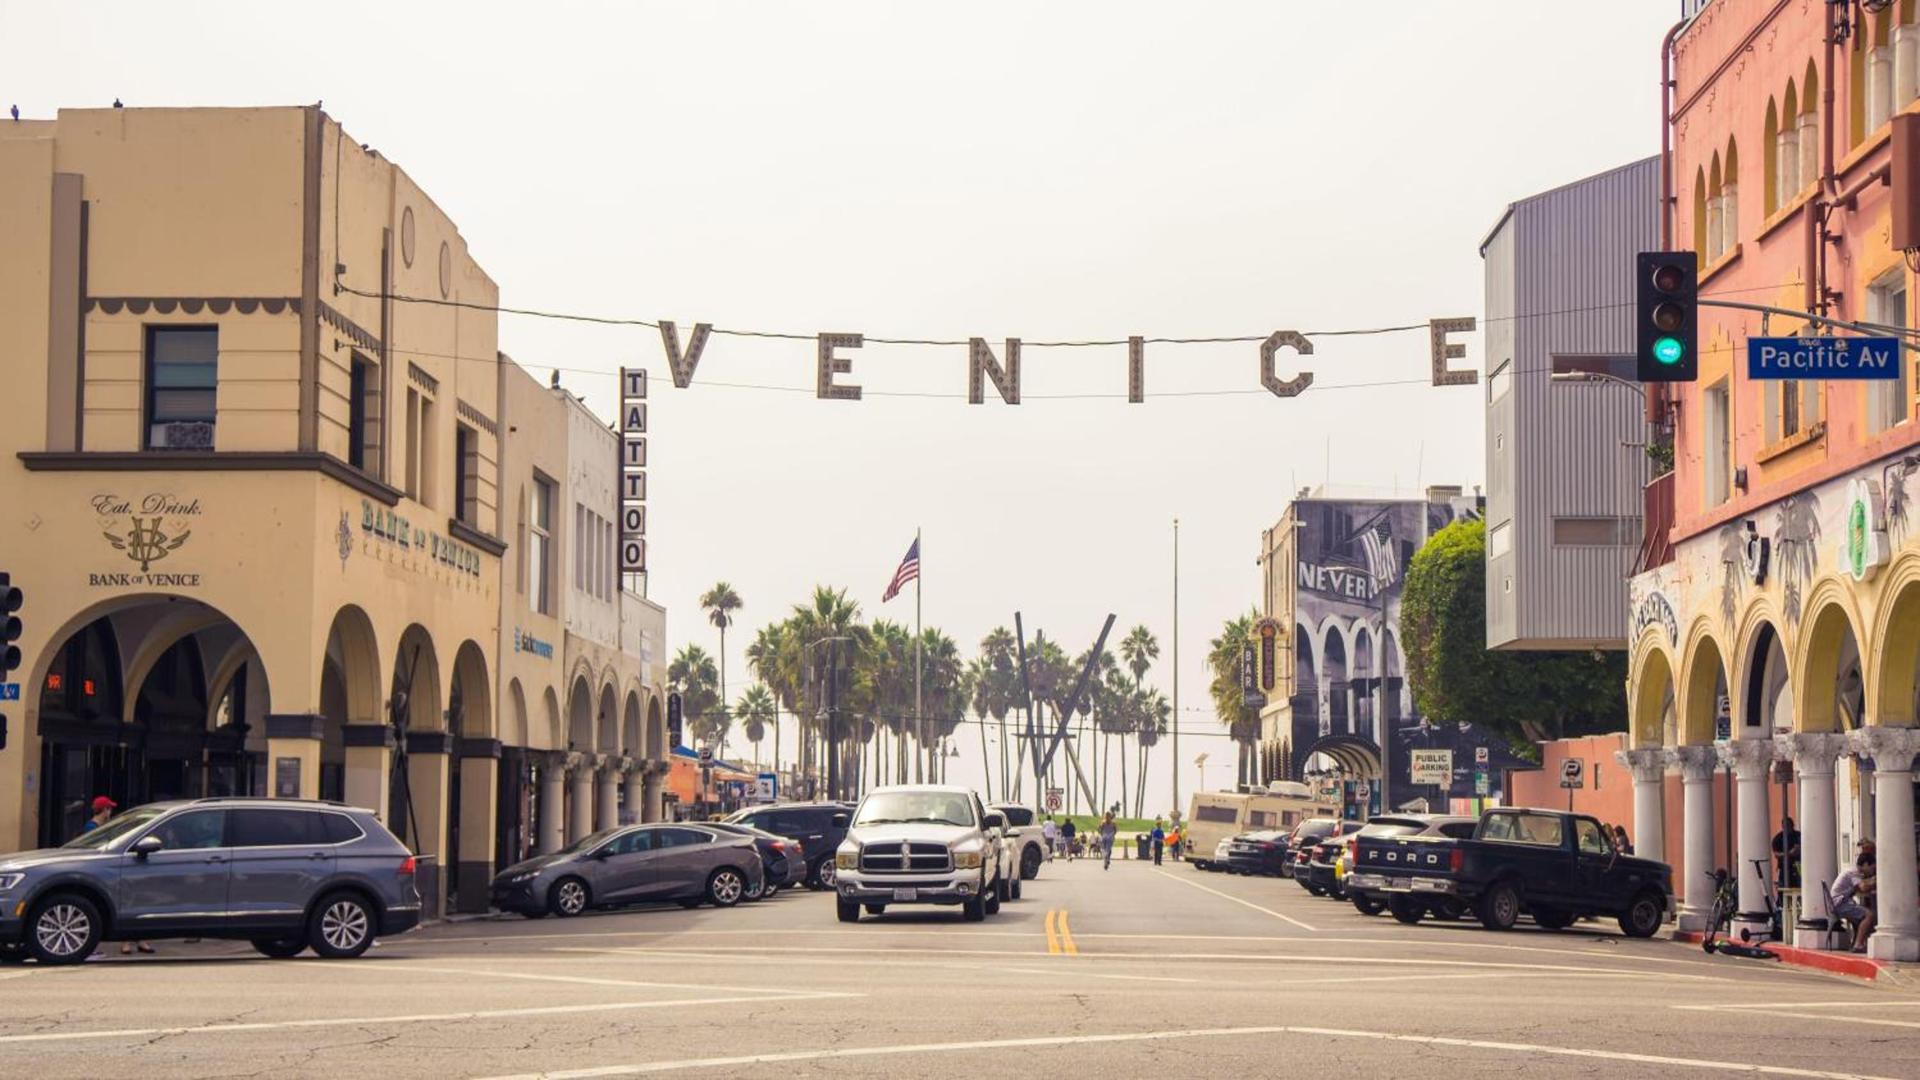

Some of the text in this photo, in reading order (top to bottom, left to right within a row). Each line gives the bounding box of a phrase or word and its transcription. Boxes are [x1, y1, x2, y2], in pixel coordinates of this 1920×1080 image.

[658, 316, 1478, 404] VENICE
[1760, 345, 1889, 368] Pacific Av
[624, 372, 643, 565] TATTOO
[90, 492, 202, 516] Eat. Drink.
[361, 498, 410, 549] BANK
[429, 530, 480, 578] VENICE
[89, 573, 200, 587] BANK OF VENICE
[1415, 754, 1448, 762] PUBLIC
[1368, 850, 1438, 864] FORD
